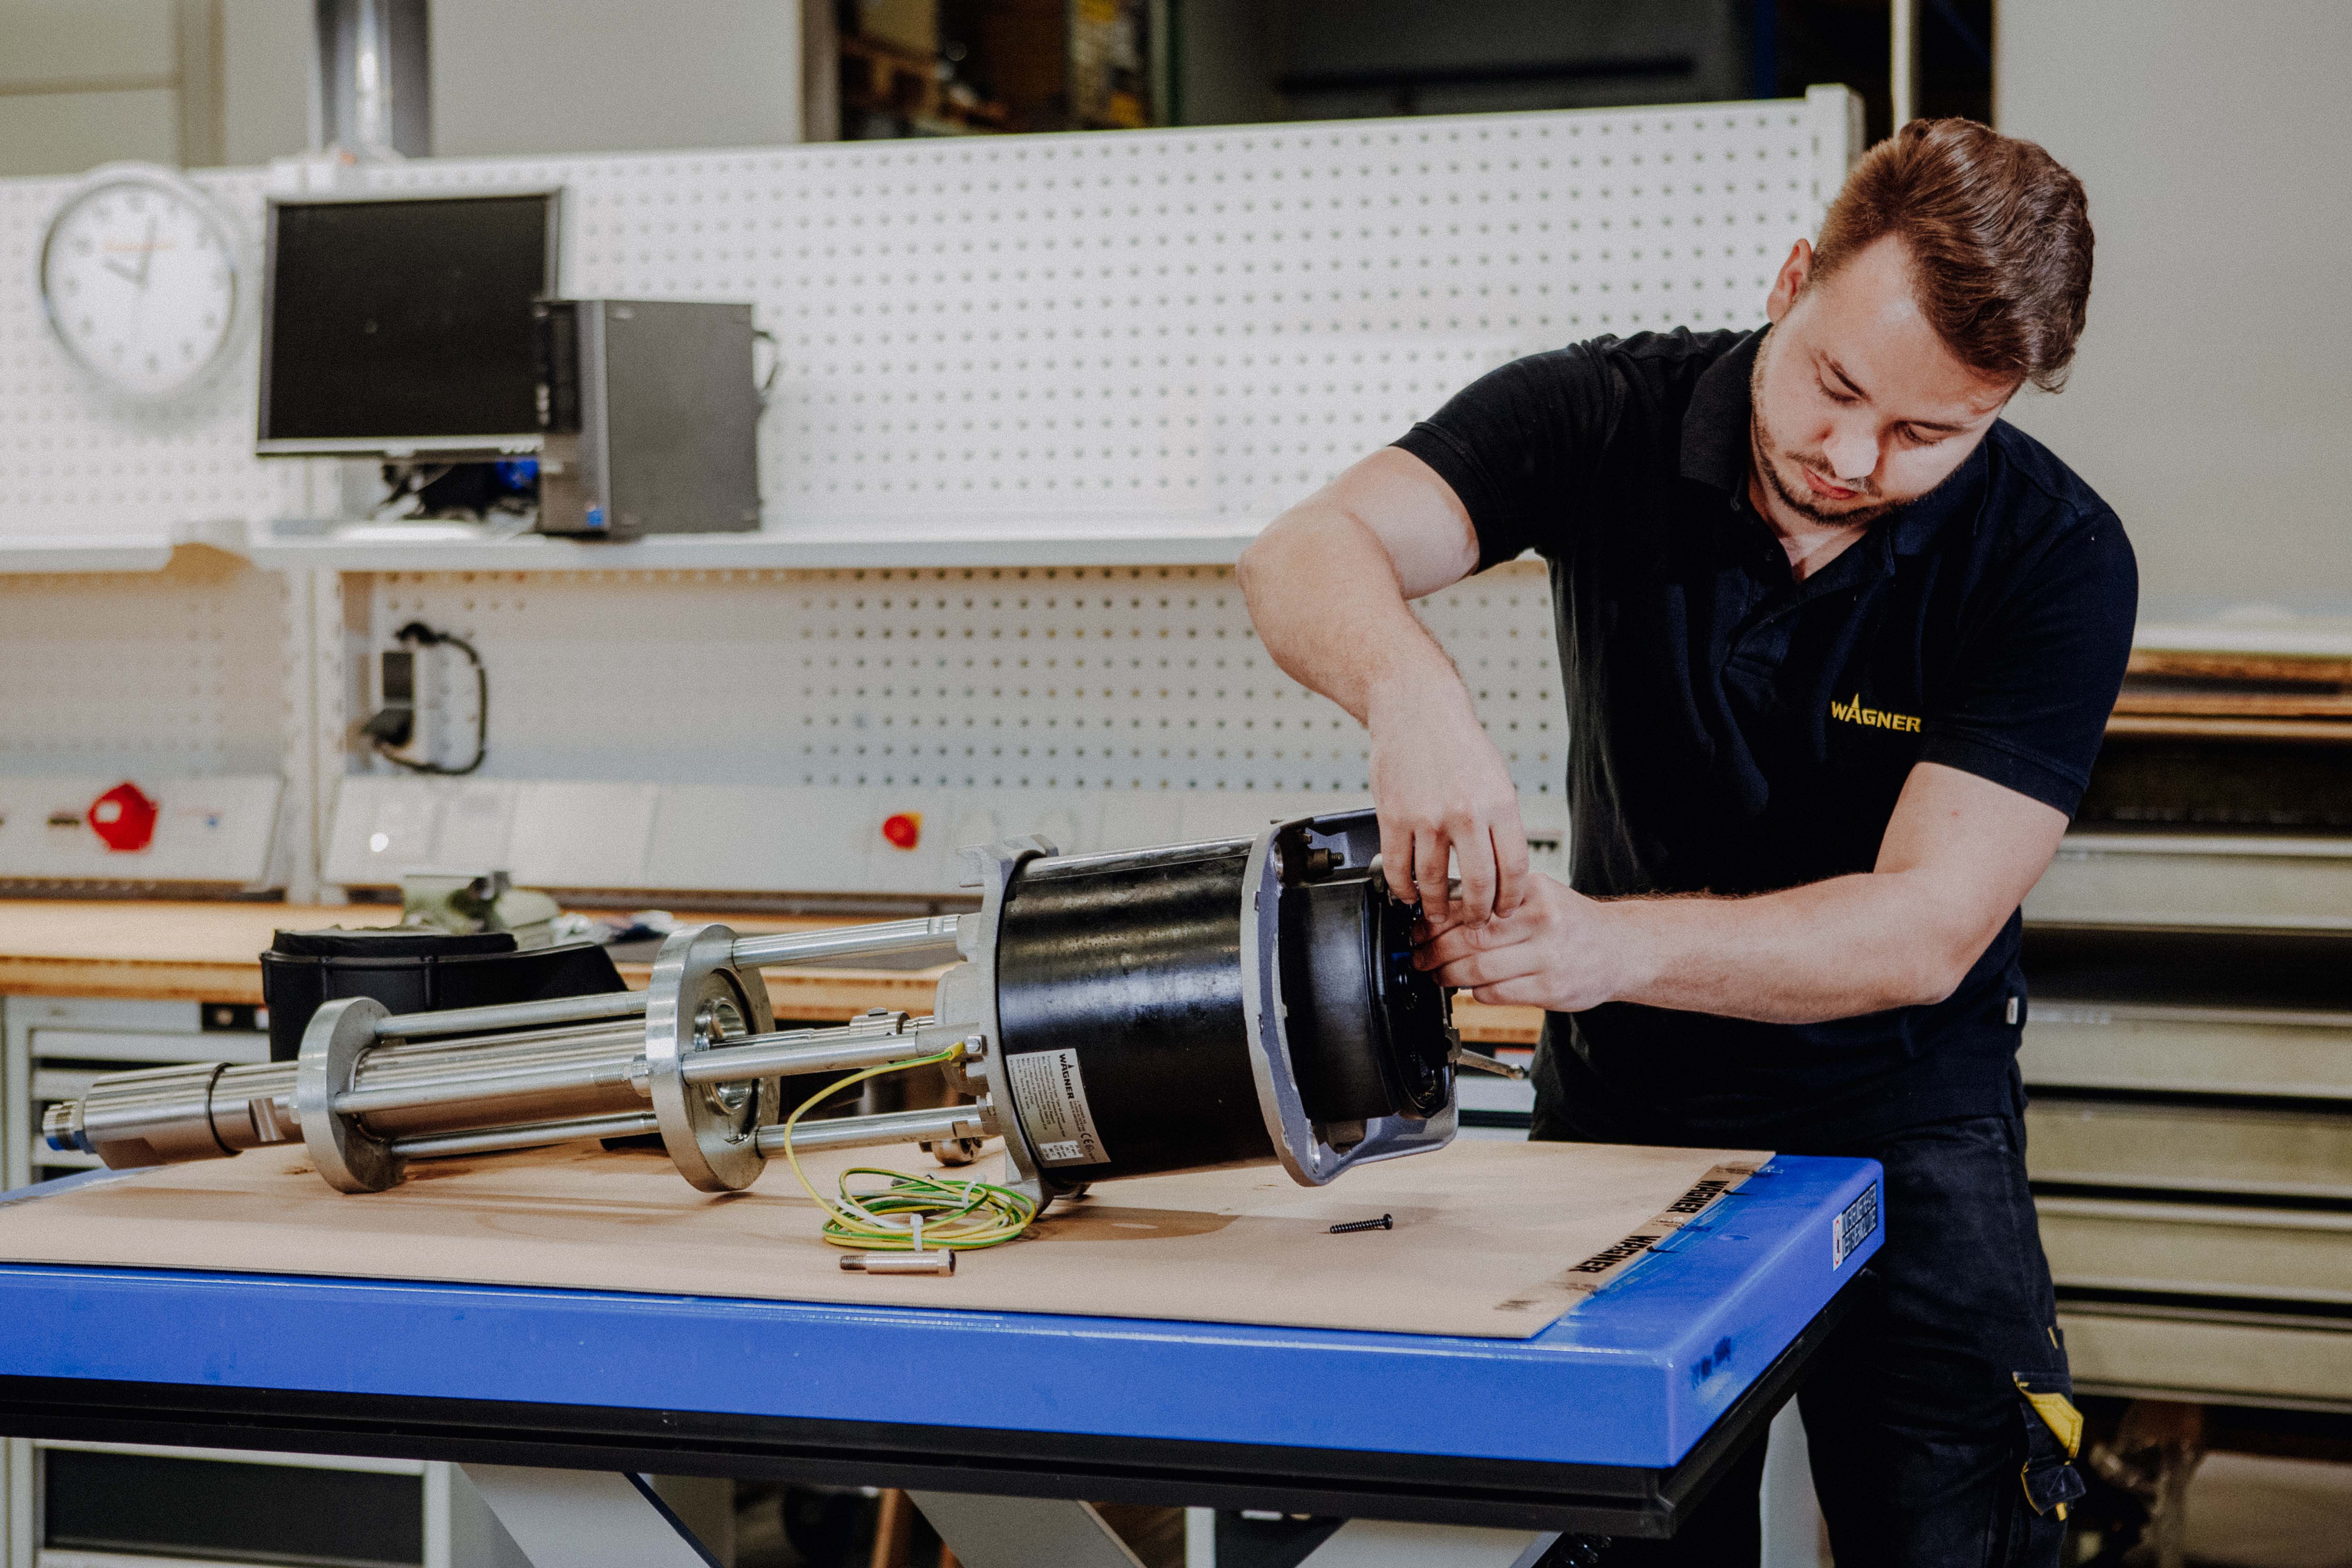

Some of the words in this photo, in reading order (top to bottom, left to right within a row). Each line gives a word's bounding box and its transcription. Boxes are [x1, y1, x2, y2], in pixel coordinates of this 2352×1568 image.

[1831, 693, 1922, 733] WAGNER
[1059, 1053, 1075, 1100] WAGNER
[1666, 1180, 1730, 1214] WAGNER
[1568, 1236, 1662, 1273] WAGNER
